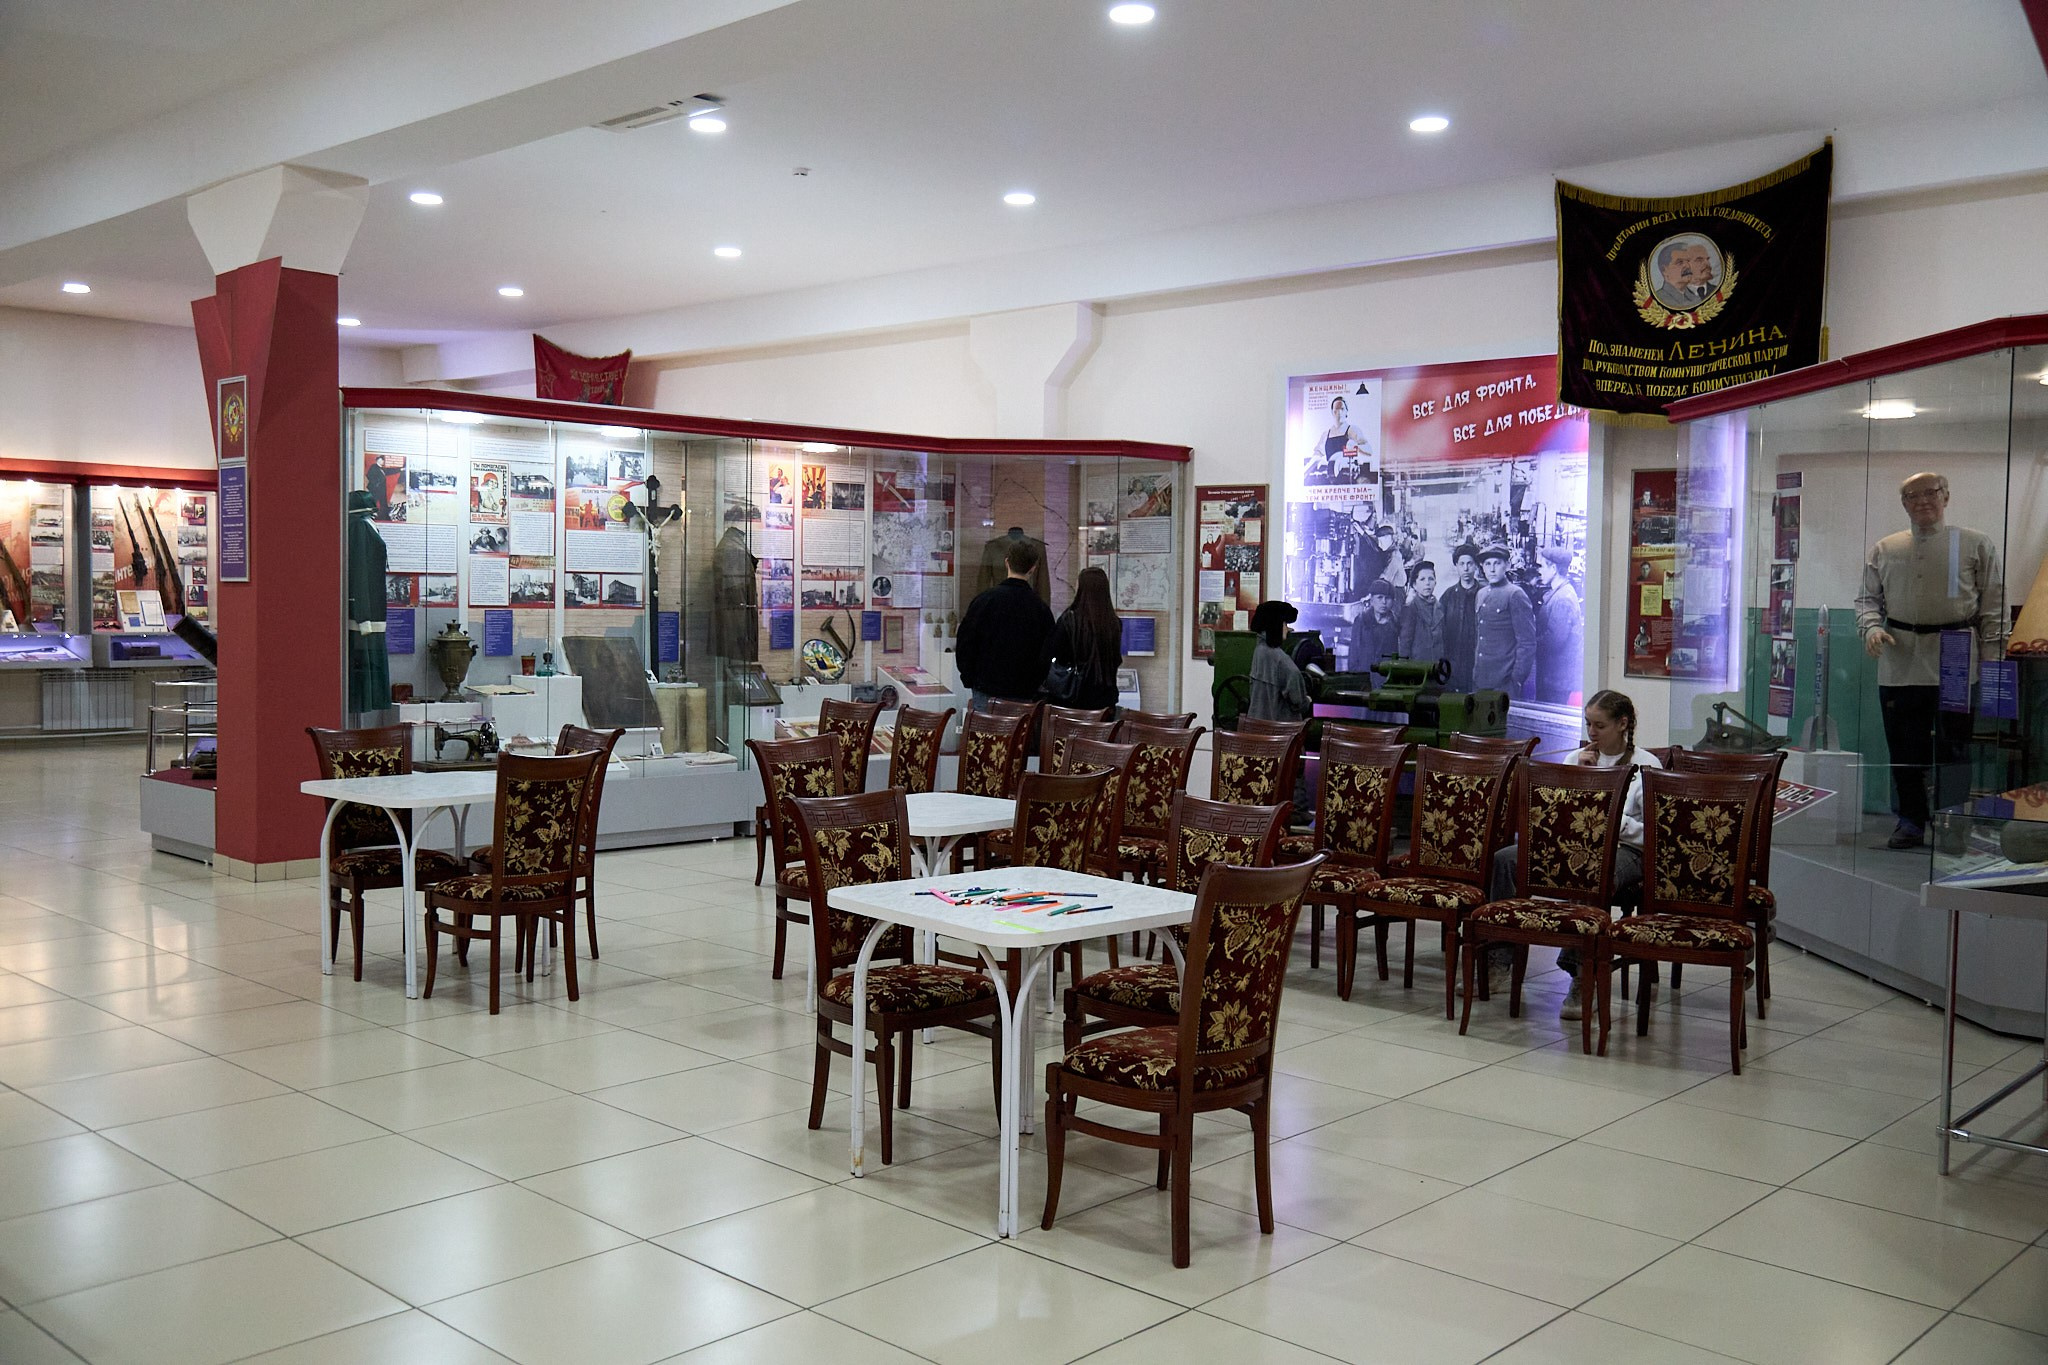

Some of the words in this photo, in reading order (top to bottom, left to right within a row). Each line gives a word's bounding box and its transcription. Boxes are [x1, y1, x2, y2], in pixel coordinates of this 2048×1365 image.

[1651, 211, 1677, 226] ВСЕХ
[1609, 344, 1664, 362] ЗНАМЕНЕМ
[1659, 352, 1751, 378] КОММУНИСТИЧЕСКОЙ
[1753, 344, 1789, 363] ПАРТИИ
[1646, 384, 1689, 398] ПОБЕДЕ
[1412, 400, 1434, 420] ВСЕ
[1442, 389, 1470, 413] ДЛЯ
[1452, 423, 1477, 443] ВСЕ
[1484, 413, 1513, 437] ДЛЯ
